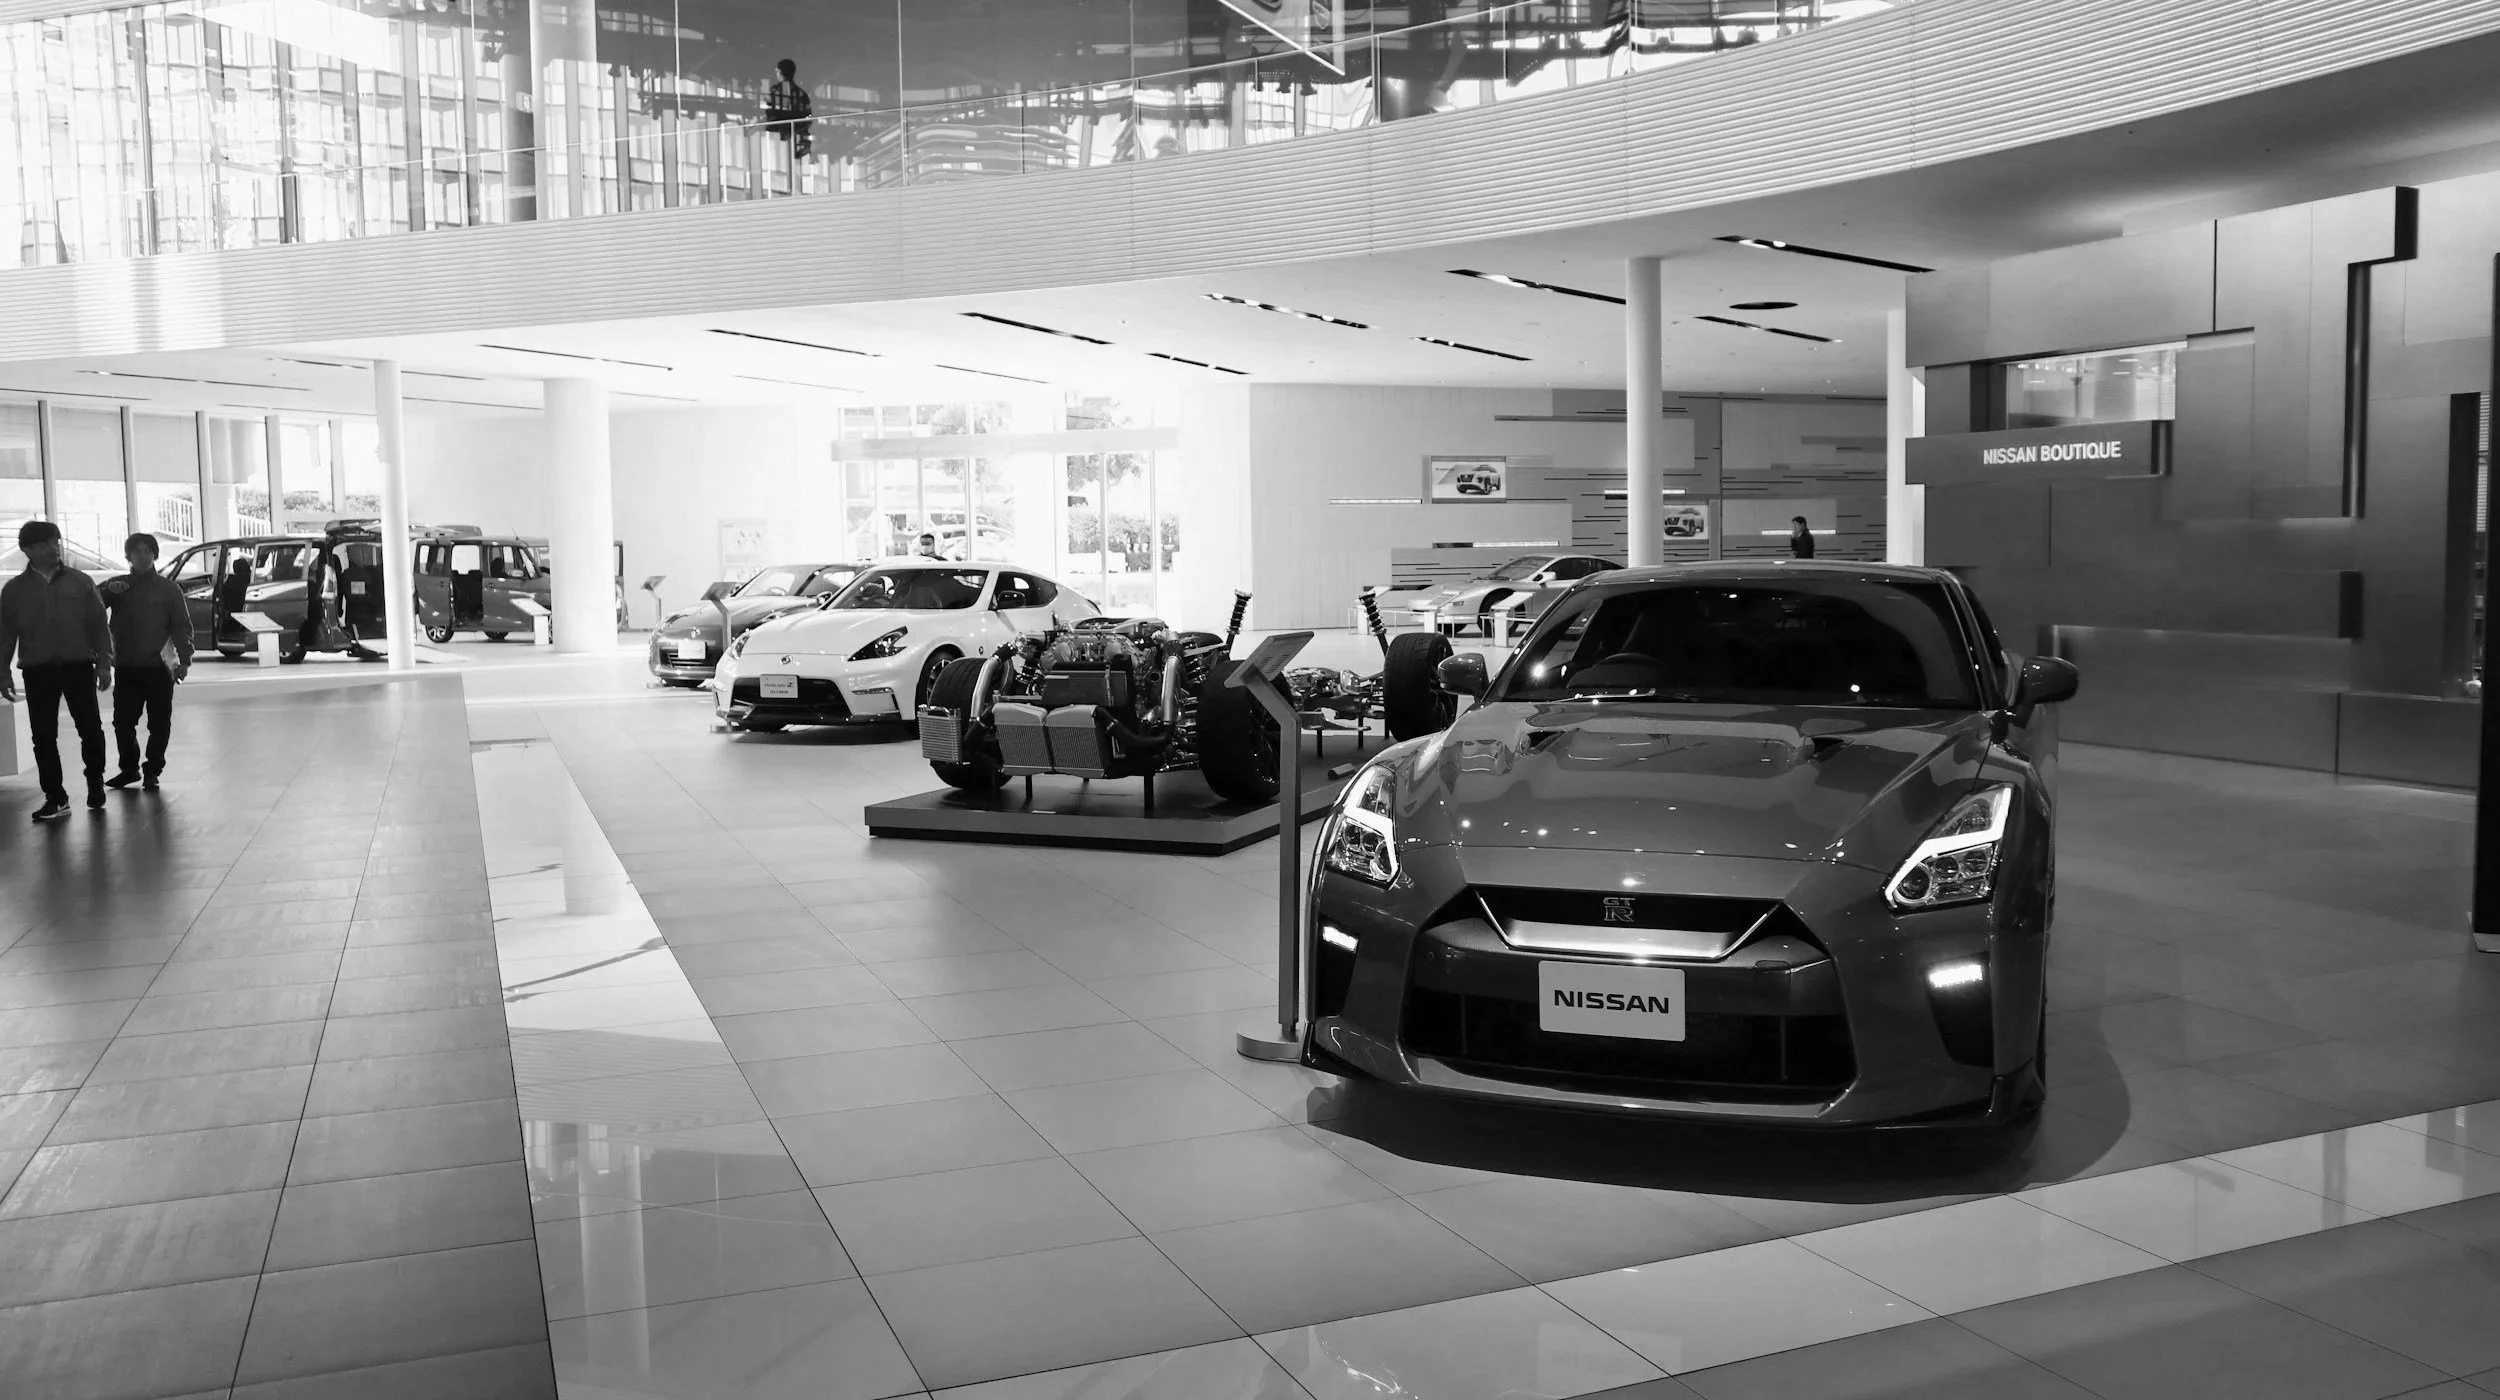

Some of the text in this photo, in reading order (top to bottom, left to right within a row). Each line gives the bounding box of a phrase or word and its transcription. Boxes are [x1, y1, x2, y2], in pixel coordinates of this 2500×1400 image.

[1983, 441, 2122, 465] NISSAN BOUTIQUE
[1603, 897, 1636, 906] GT
[1603, 905, 1635, 922] R
[1554, 989, 1669, 1014] NISSAN
